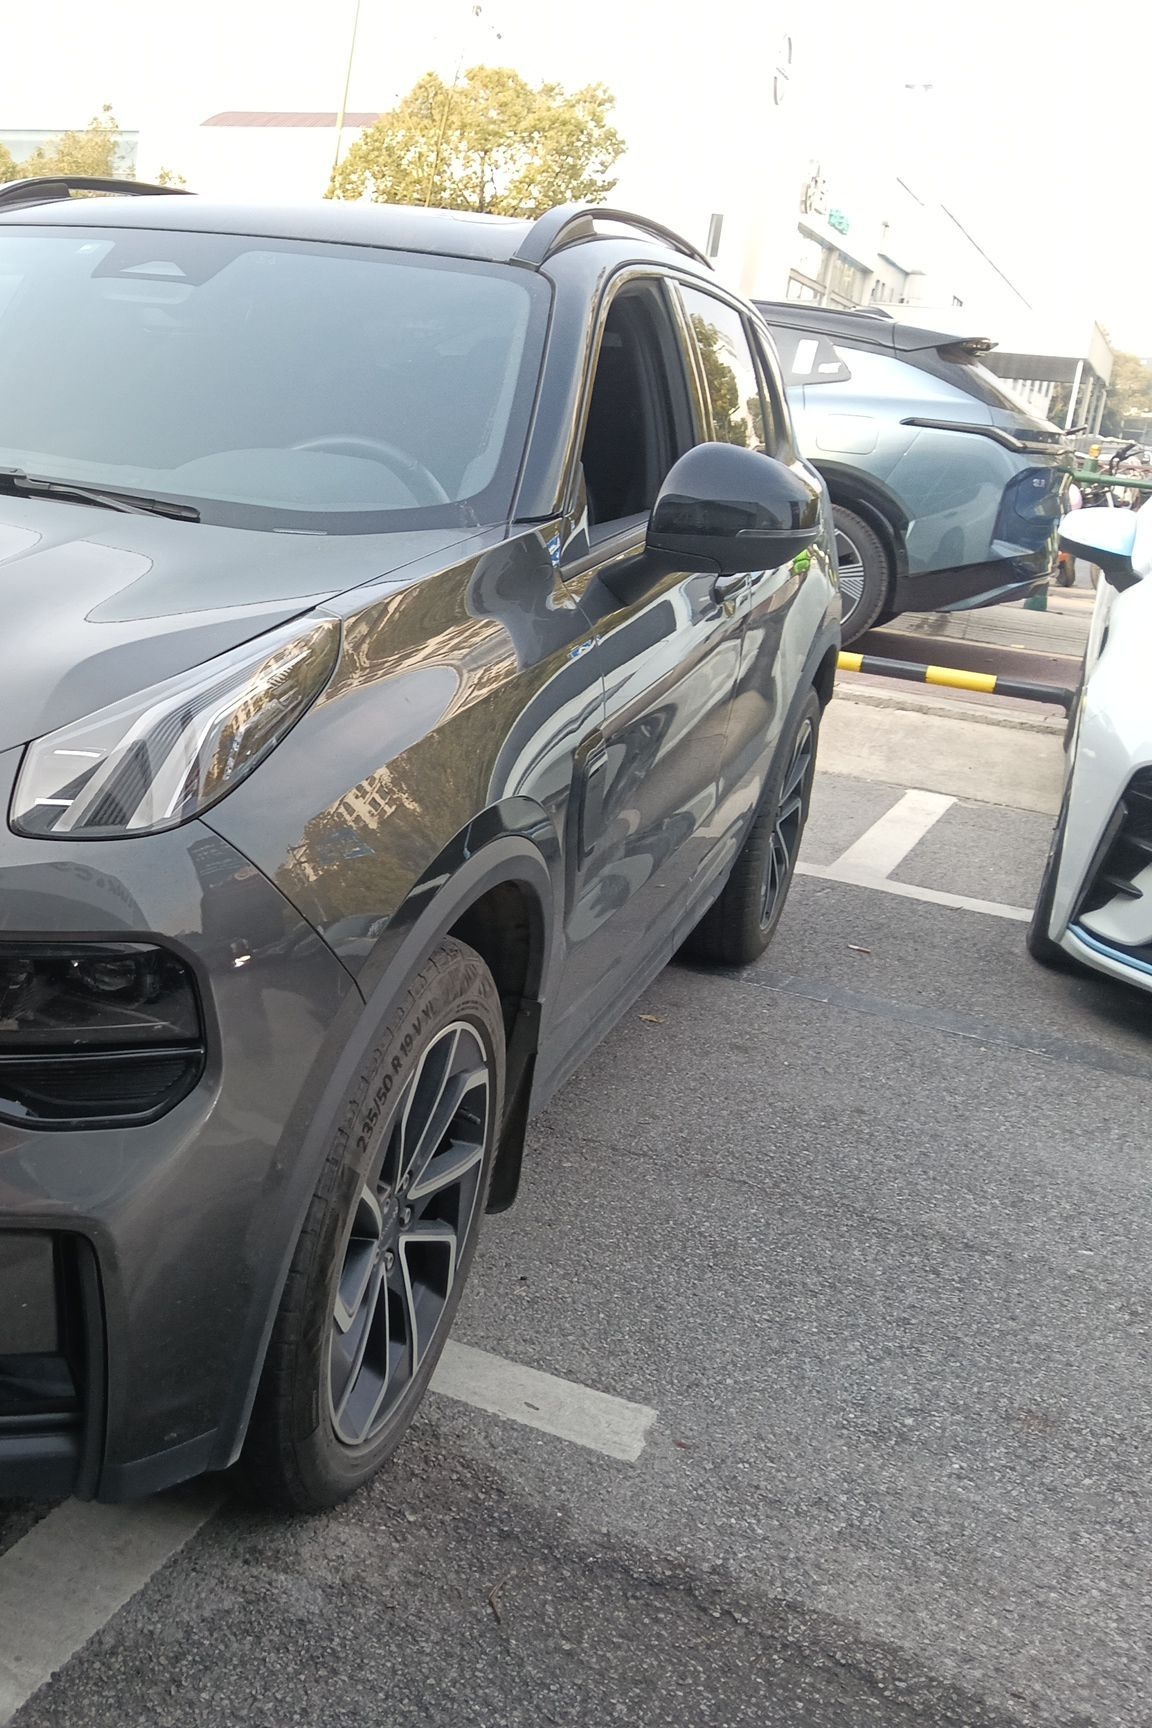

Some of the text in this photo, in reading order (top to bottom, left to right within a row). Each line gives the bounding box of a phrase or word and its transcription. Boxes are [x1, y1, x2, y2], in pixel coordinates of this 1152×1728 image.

[355, 1074, 393, 1153] 235/50
[391, 1056, 403, 1074] R
[399, 1034, 414, 1058] 19
